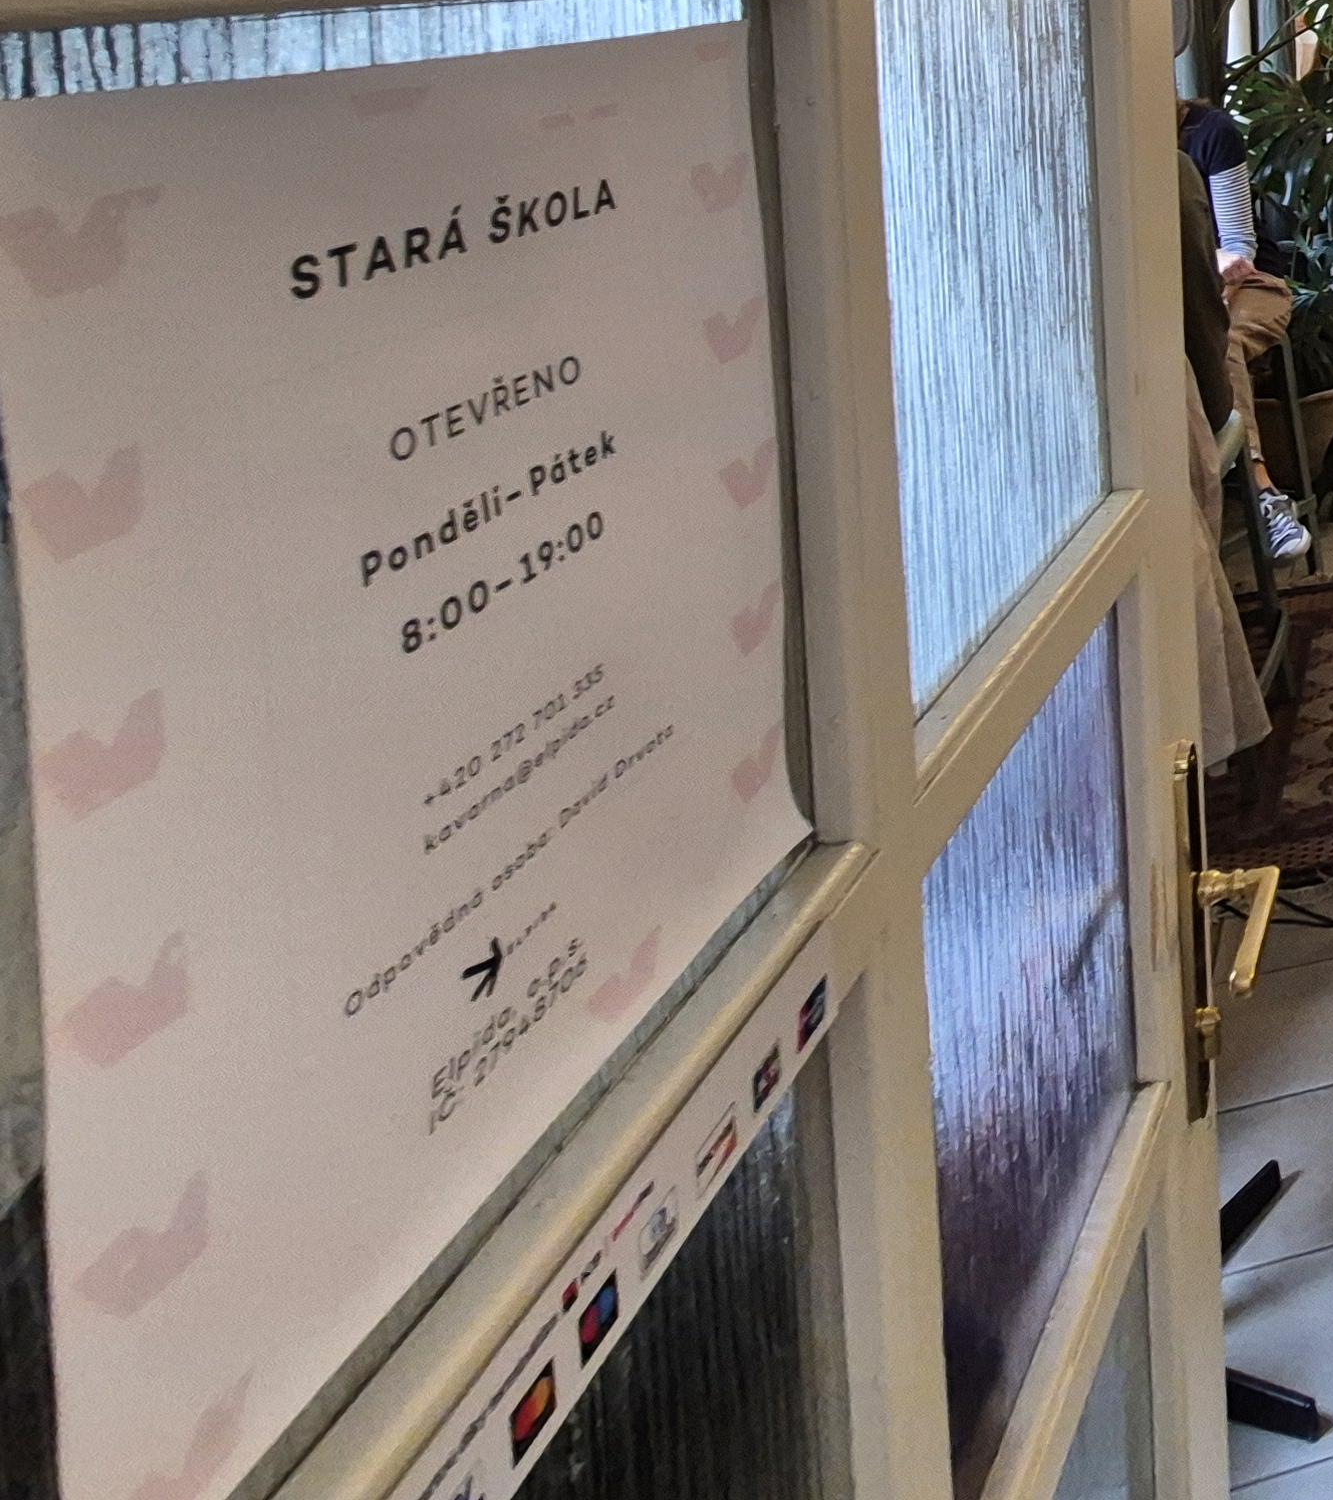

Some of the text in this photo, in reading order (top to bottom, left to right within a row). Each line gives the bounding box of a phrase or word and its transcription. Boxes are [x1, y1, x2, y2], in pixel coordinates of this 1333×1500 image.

[291, 179, 616, 299] STARÁ ŠKOLA
[389, 356, 581, 461] OTEVŘENO
